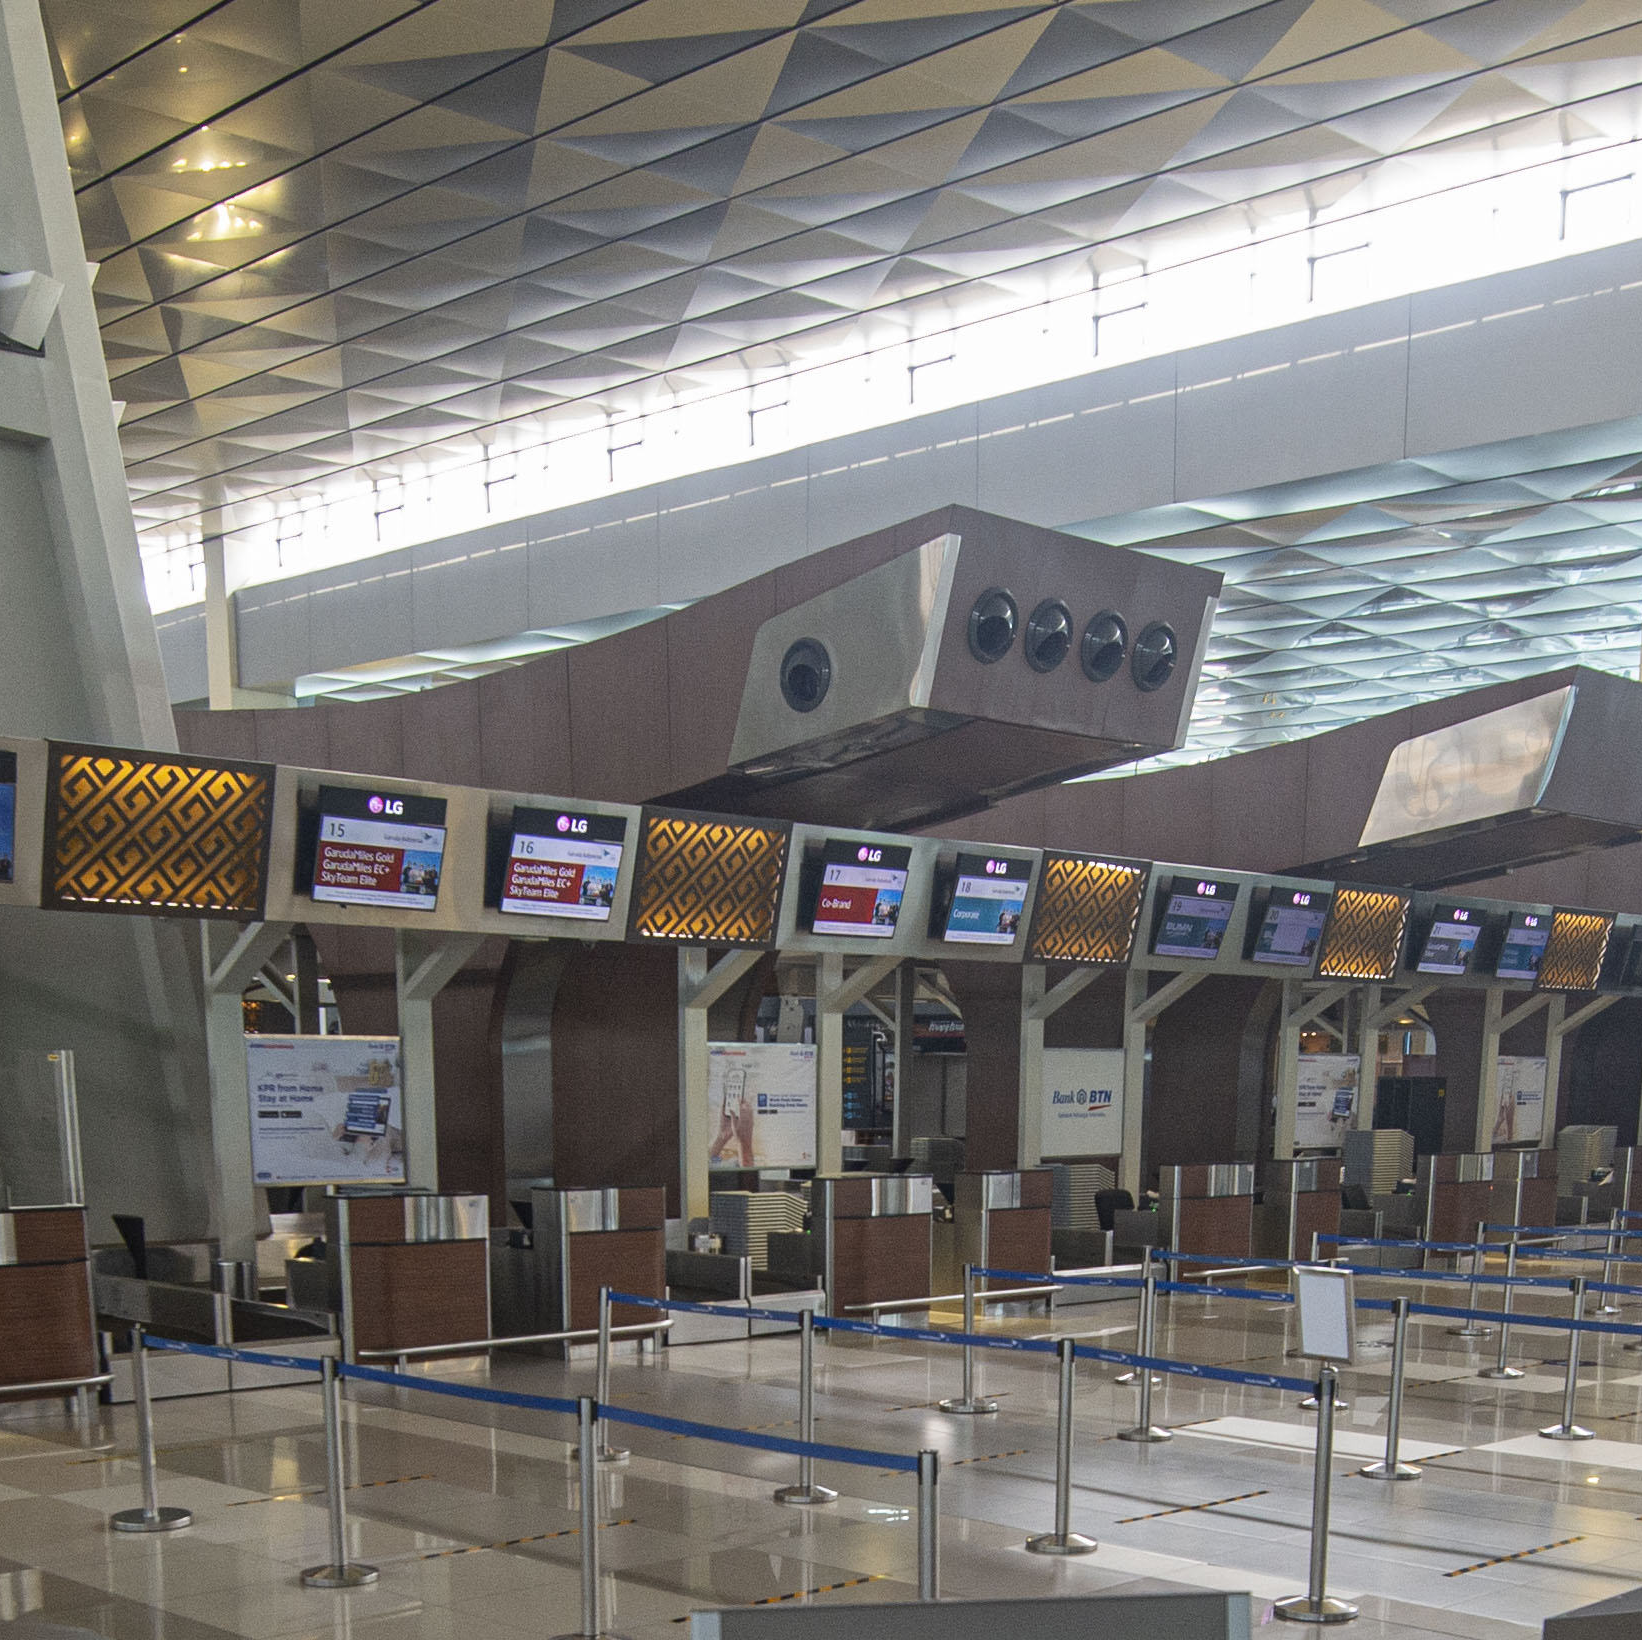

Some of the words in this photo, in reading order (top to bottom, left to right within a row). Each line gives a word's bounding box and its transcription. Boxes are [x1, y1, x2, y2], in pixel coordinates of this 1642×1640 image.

[385, 800, 404, 815] LG
[329, 823, 346, 838] 15
[571, 818, 588, 834] LG
[519, 840, 534, 854] 16
[375, 852, 395, 864] Gold
[868, 850, 882, 862] LG
[829, 869, 841, 881] 17
[995, 862, 1008, 874] LG
[1052, 1089, 1076, 1104] Bank
[1089, 1089, 1113, 1103] BTN
